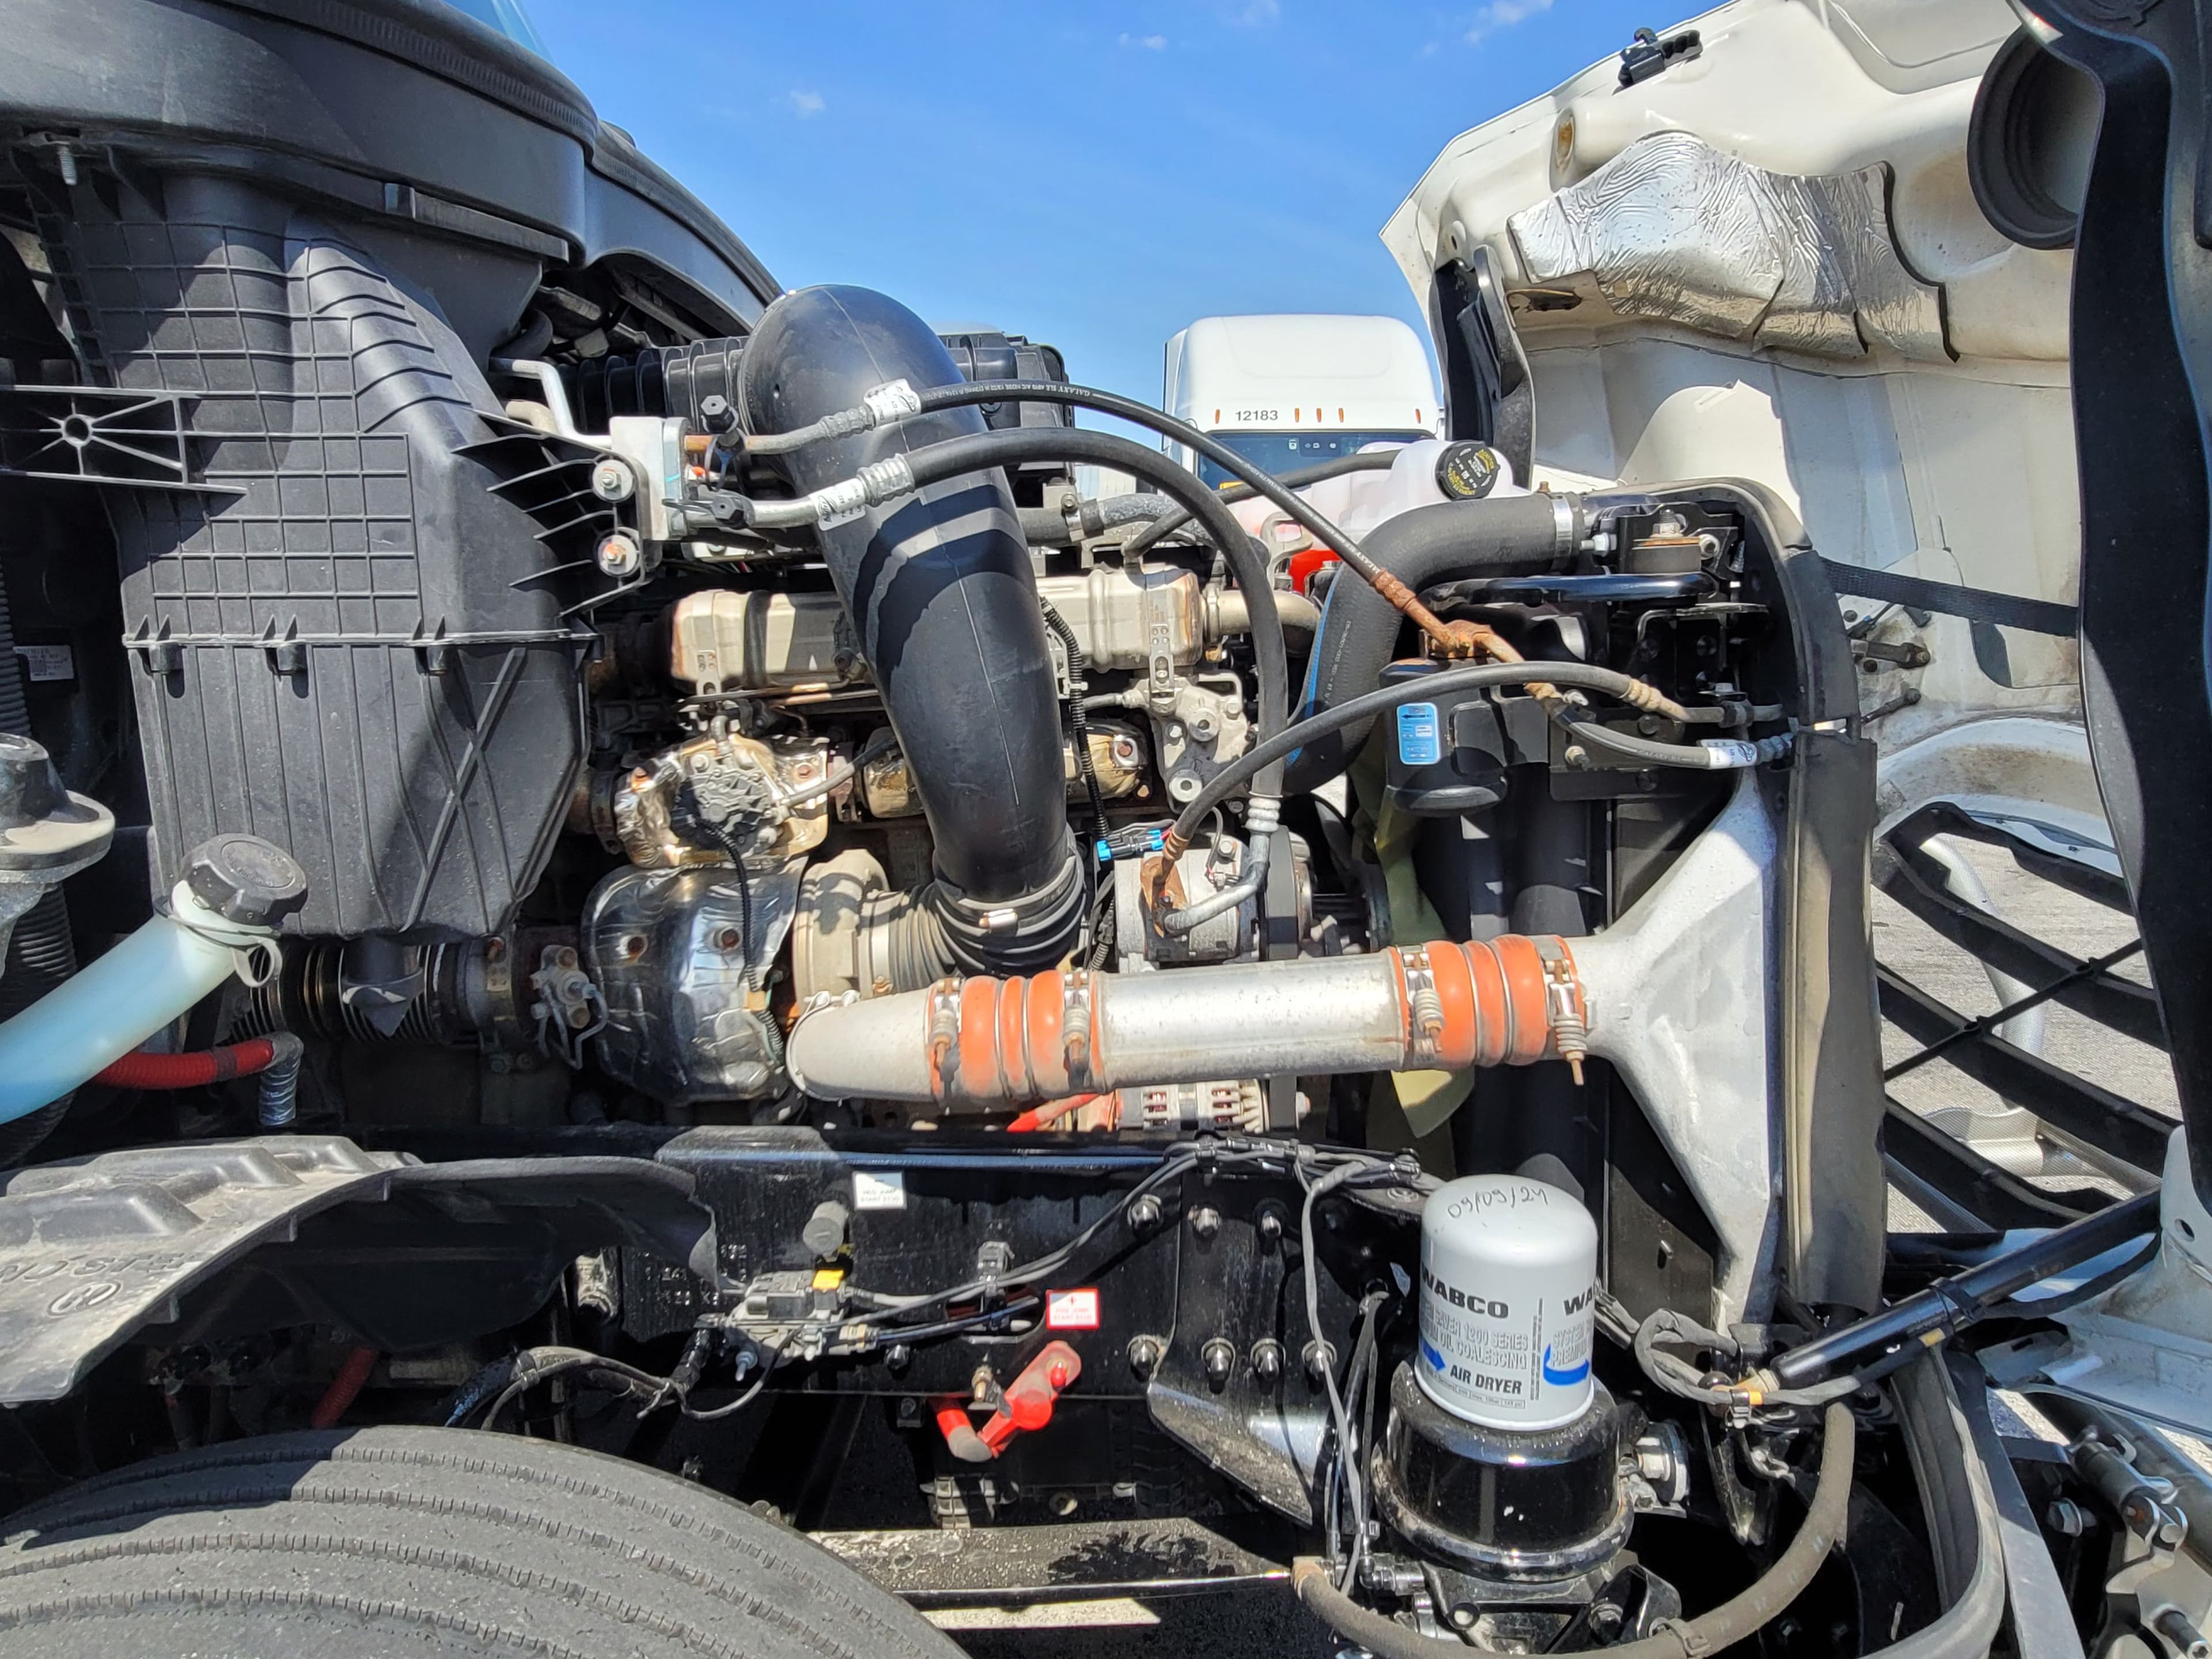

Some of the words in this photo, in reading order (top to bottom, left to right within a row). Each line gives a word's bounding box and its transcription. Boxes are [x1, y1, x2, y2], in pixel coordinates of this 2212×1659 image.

[1058, 385, 1090, 396] GALAXY
[1235, 410, 1278, 421] 12183
[1435, 1305, 1461, 1337] SAVER
[1464, 1323, 1488, 1346] 1200
[1491, 1331, 1529, 1351] SERIES
[1440, 1332, 1454, 1353] OIL
[1457, 1339, 1527, 1370] COALESCING
[1450, 1365, 1471, 1385] AIR
[1475, 1374, 1522, 1395] DRYER
